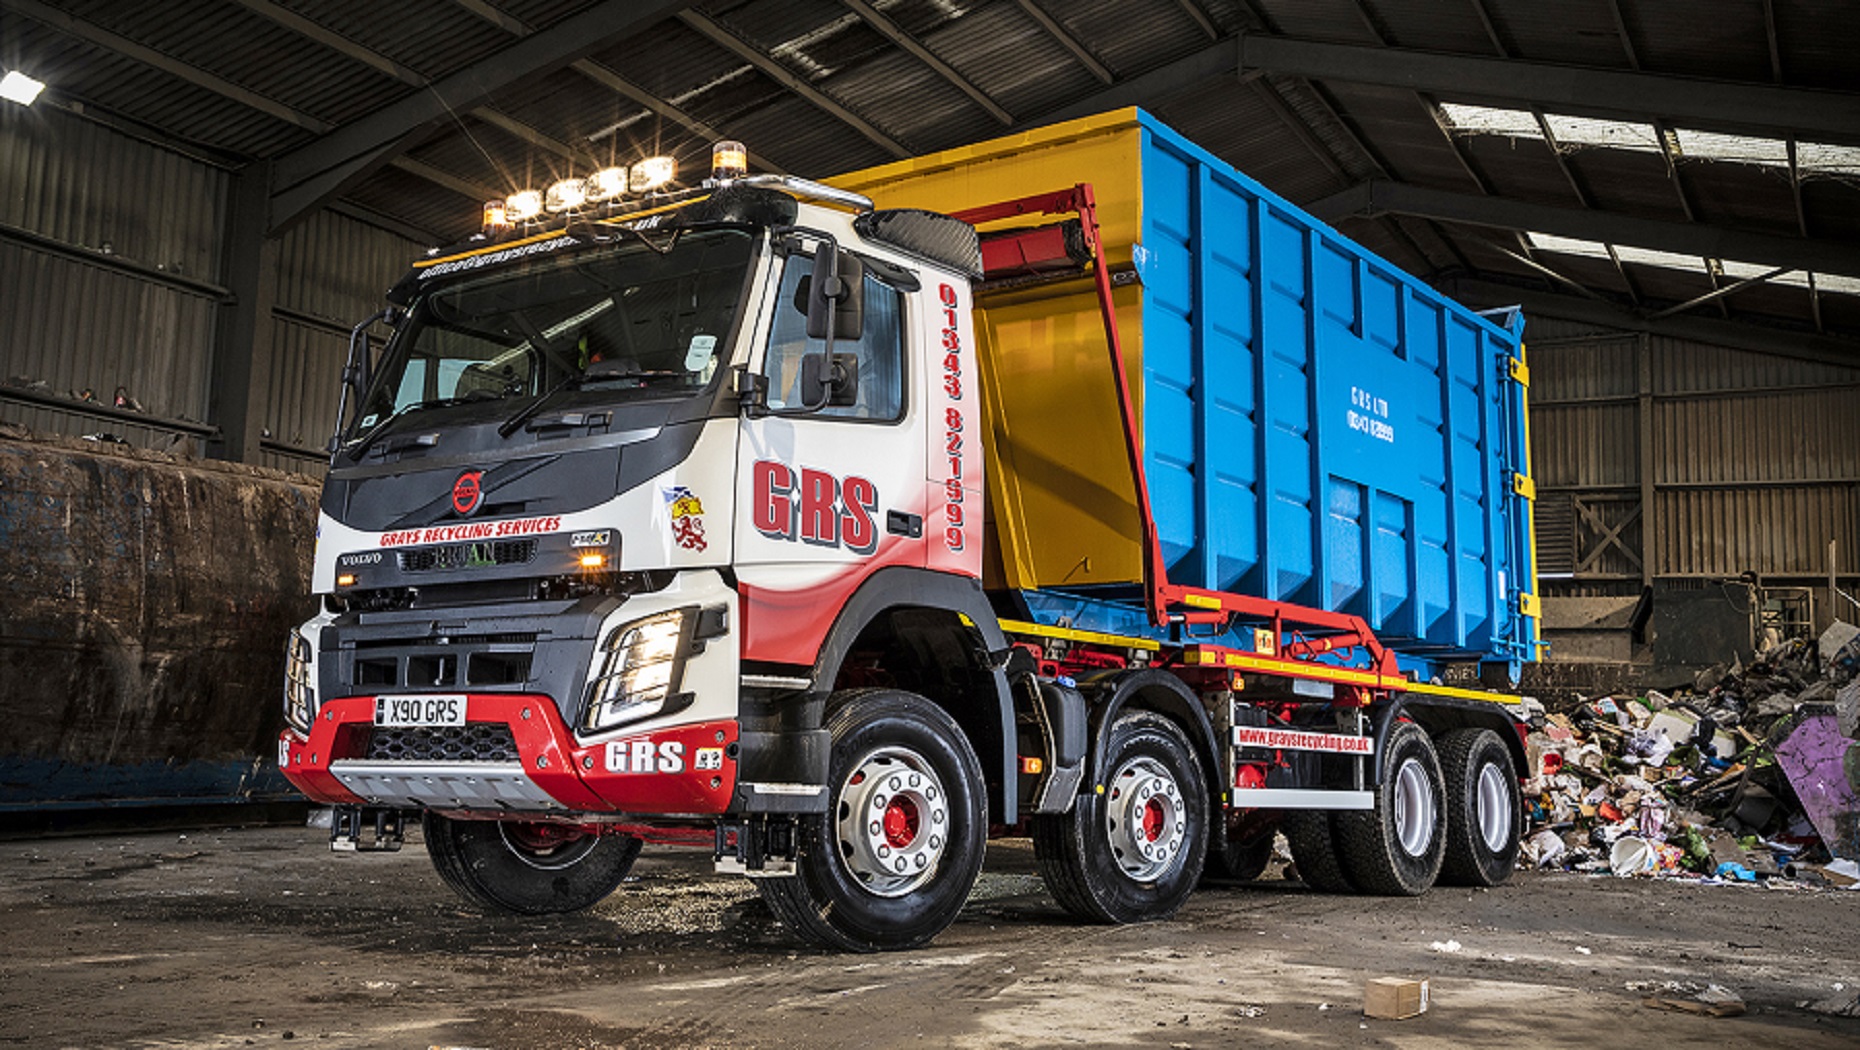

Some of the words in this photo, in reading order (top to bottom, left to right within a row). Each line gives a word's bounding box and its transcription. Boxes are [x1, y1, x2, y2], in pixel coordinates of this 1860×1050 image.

[939, 283, 962, 401] 01343
[945, 407, 964, 552] 821999
[752, 460, 879, 556] GRS
[380, 530, 422, 547] GRAYS
[423, 522, 493, 543] RECYCLING
[496, 515, 562, 537] SERVICES
[341, 553, 382, 566] VOLVO
[390, 700, 421, 722] X90
[425, 700, 458, 723] GRS
[1239, 729, 1369, 752] www.graysrecycling.co.uk
[605, 741, 687, 775] GRS
